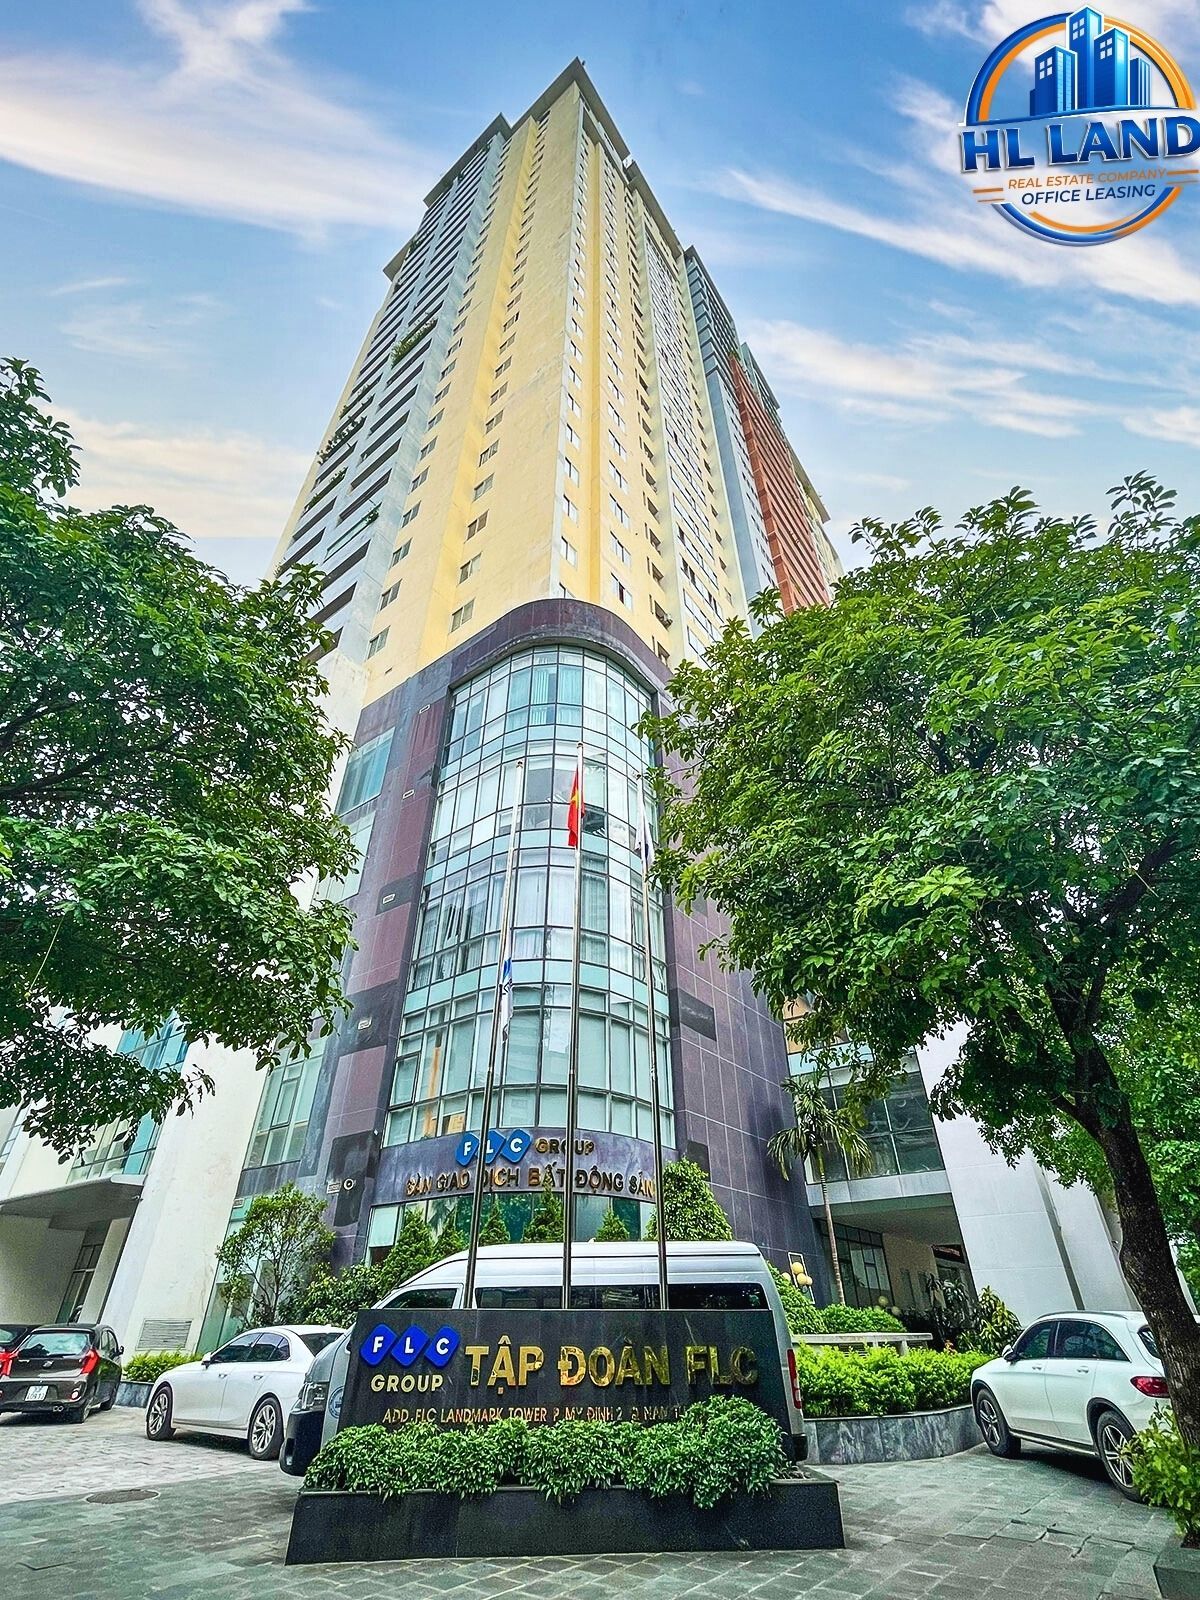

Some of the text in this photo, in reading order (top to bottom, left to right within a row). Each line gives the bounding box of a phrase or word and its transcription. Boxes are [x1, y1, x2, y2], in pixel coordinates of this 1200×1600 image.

[574, 1165, 624, 1194] ĐỘNG
[372, 1335, 450, 1355] FLC
[465, 1334, 759, 1395] TẬP ĐOÀN FLC
[370, 1374, 444, 1393] GROUP
[440, 1407, 504, 1424] LANDMARK
[508, 1406, 548, 1422] TOWER
